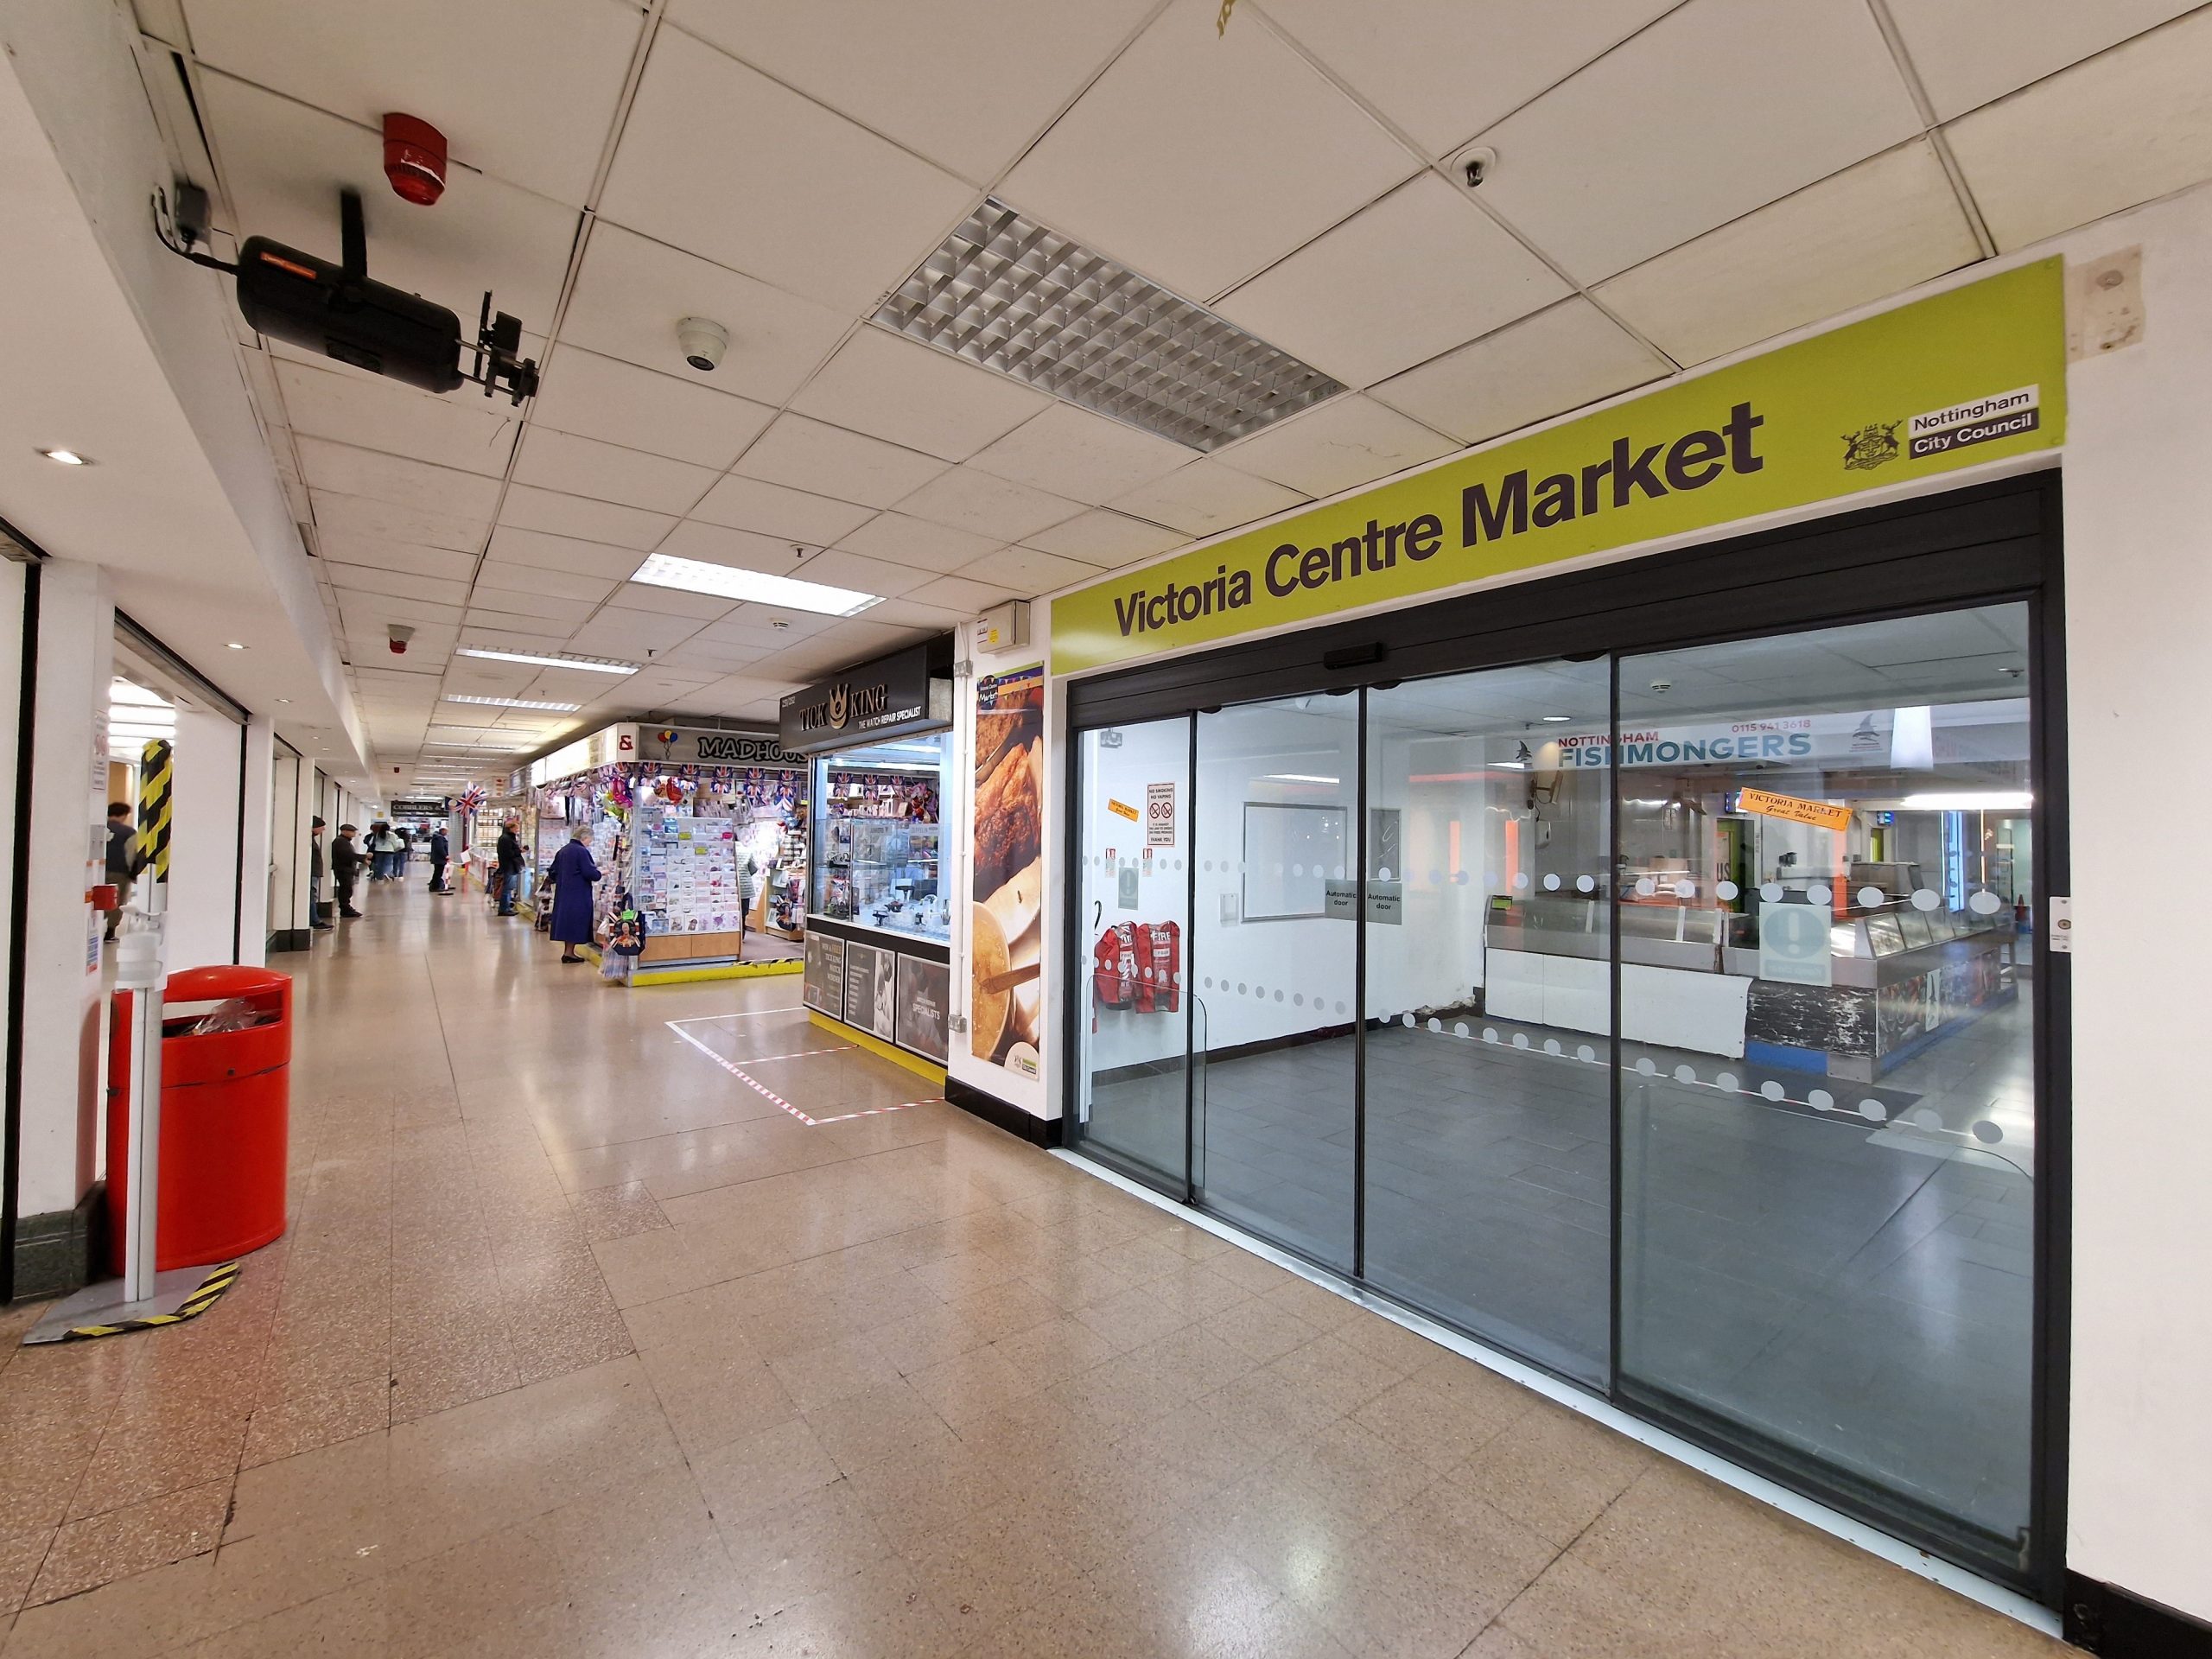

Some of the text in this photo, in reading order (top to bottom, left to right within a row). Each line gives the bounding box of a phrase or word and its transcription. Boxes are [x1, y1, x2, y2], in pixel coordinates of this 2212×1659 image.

[1914, 393, 2030, 431] Nottingham
[1914, 412, 2033, 454] City Council
[1114, 402, 1764, 637] Victoria Centre Market
[979, 691, 998, 702] Market
[799, 684, 887, 731] TICK KING
[866, 716, 881, 728] WATCH
[881, 712, 897, 725] REPAIR
[896, 706, 922, 721] SPECIALIST
[1732, 719, 1812, 734] 0115 941 3618
[619, 735, 633, 750] &
[1558, 732, 1659, 747] NOTTINHAM
[1750, 793, 1842, 818] VICTORIA MARKET
[1766, 805, 1790, 815] Great
[1325, 890, 1357, 899] Automatic
[1368, 893, 1401, 902] Automatic
[912, 1002, 940, 1020] SPECIALISTS
